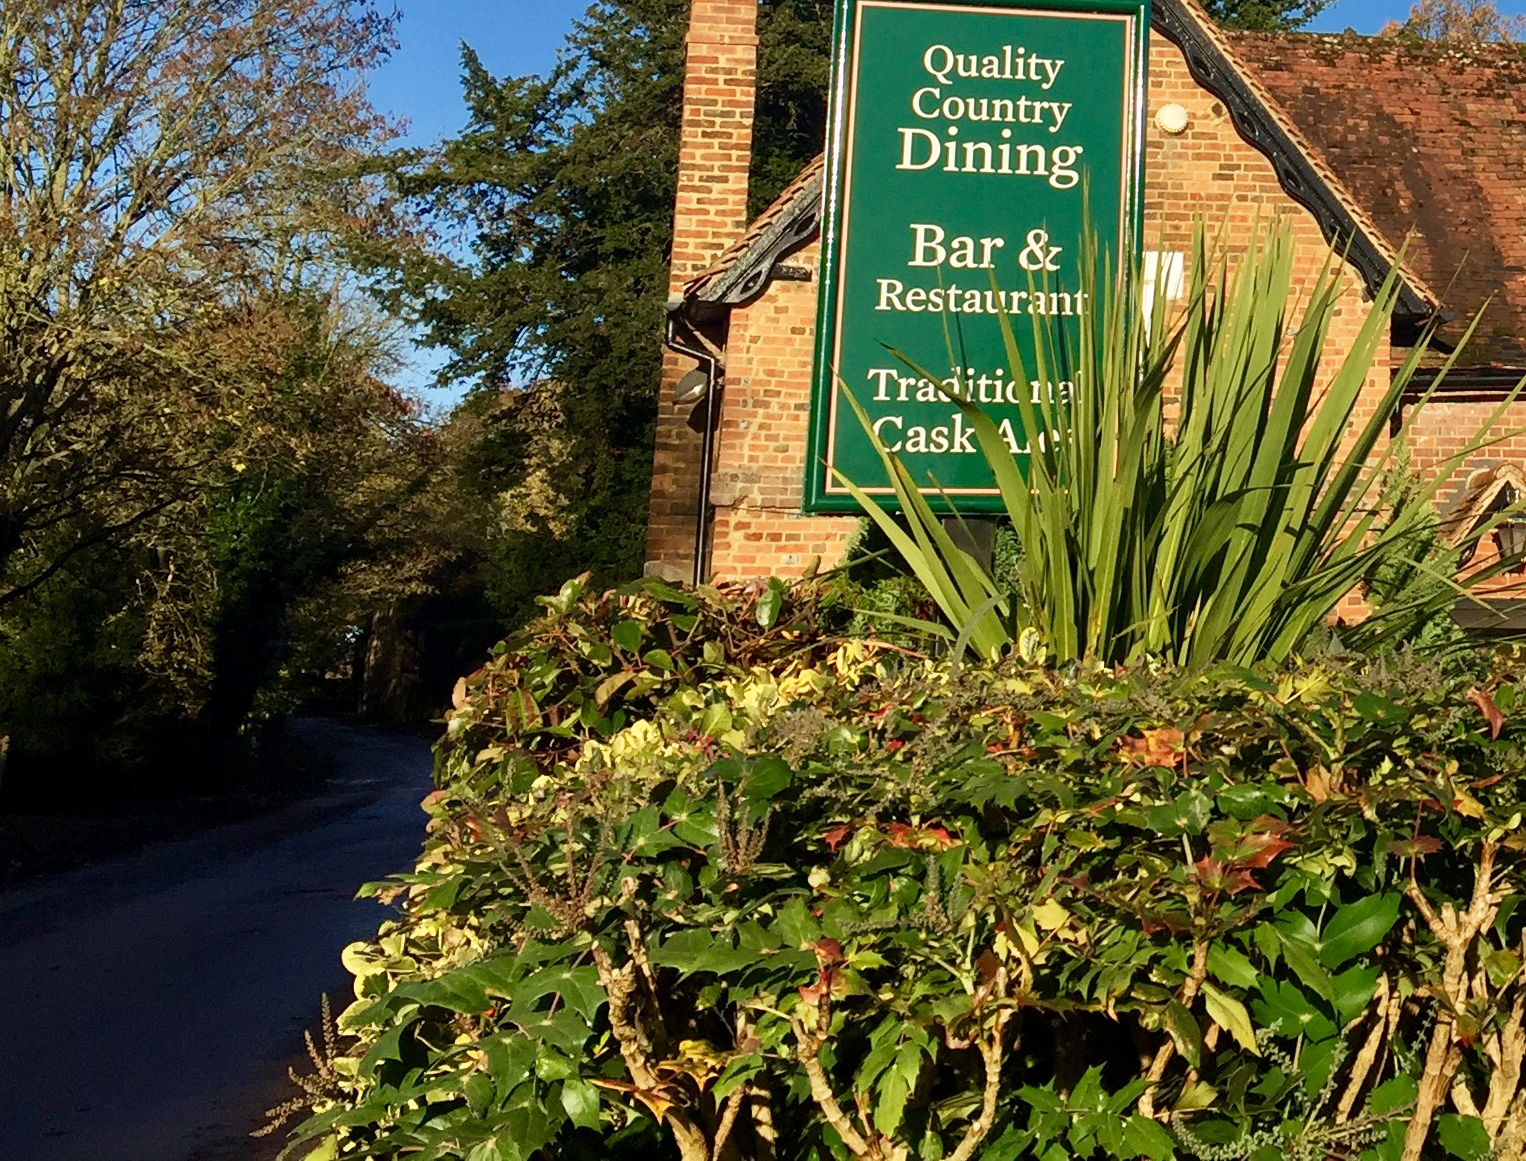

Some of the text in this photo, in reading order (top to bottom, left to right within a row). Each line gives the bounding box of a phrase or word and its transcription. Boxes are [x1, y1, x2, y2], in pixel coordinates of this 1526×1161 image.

[922, 44, 1065, 89] Quality
[912, 87, 1073, 132] Country
[895, 126, 1084, 189] Dining
[908, 223, 1062, 272] Bar &
[874, 278, 1090, 316] Restaurant
[867, 366, 1084, 404] Traditiona
[872, 413, 977, 453] Cask
